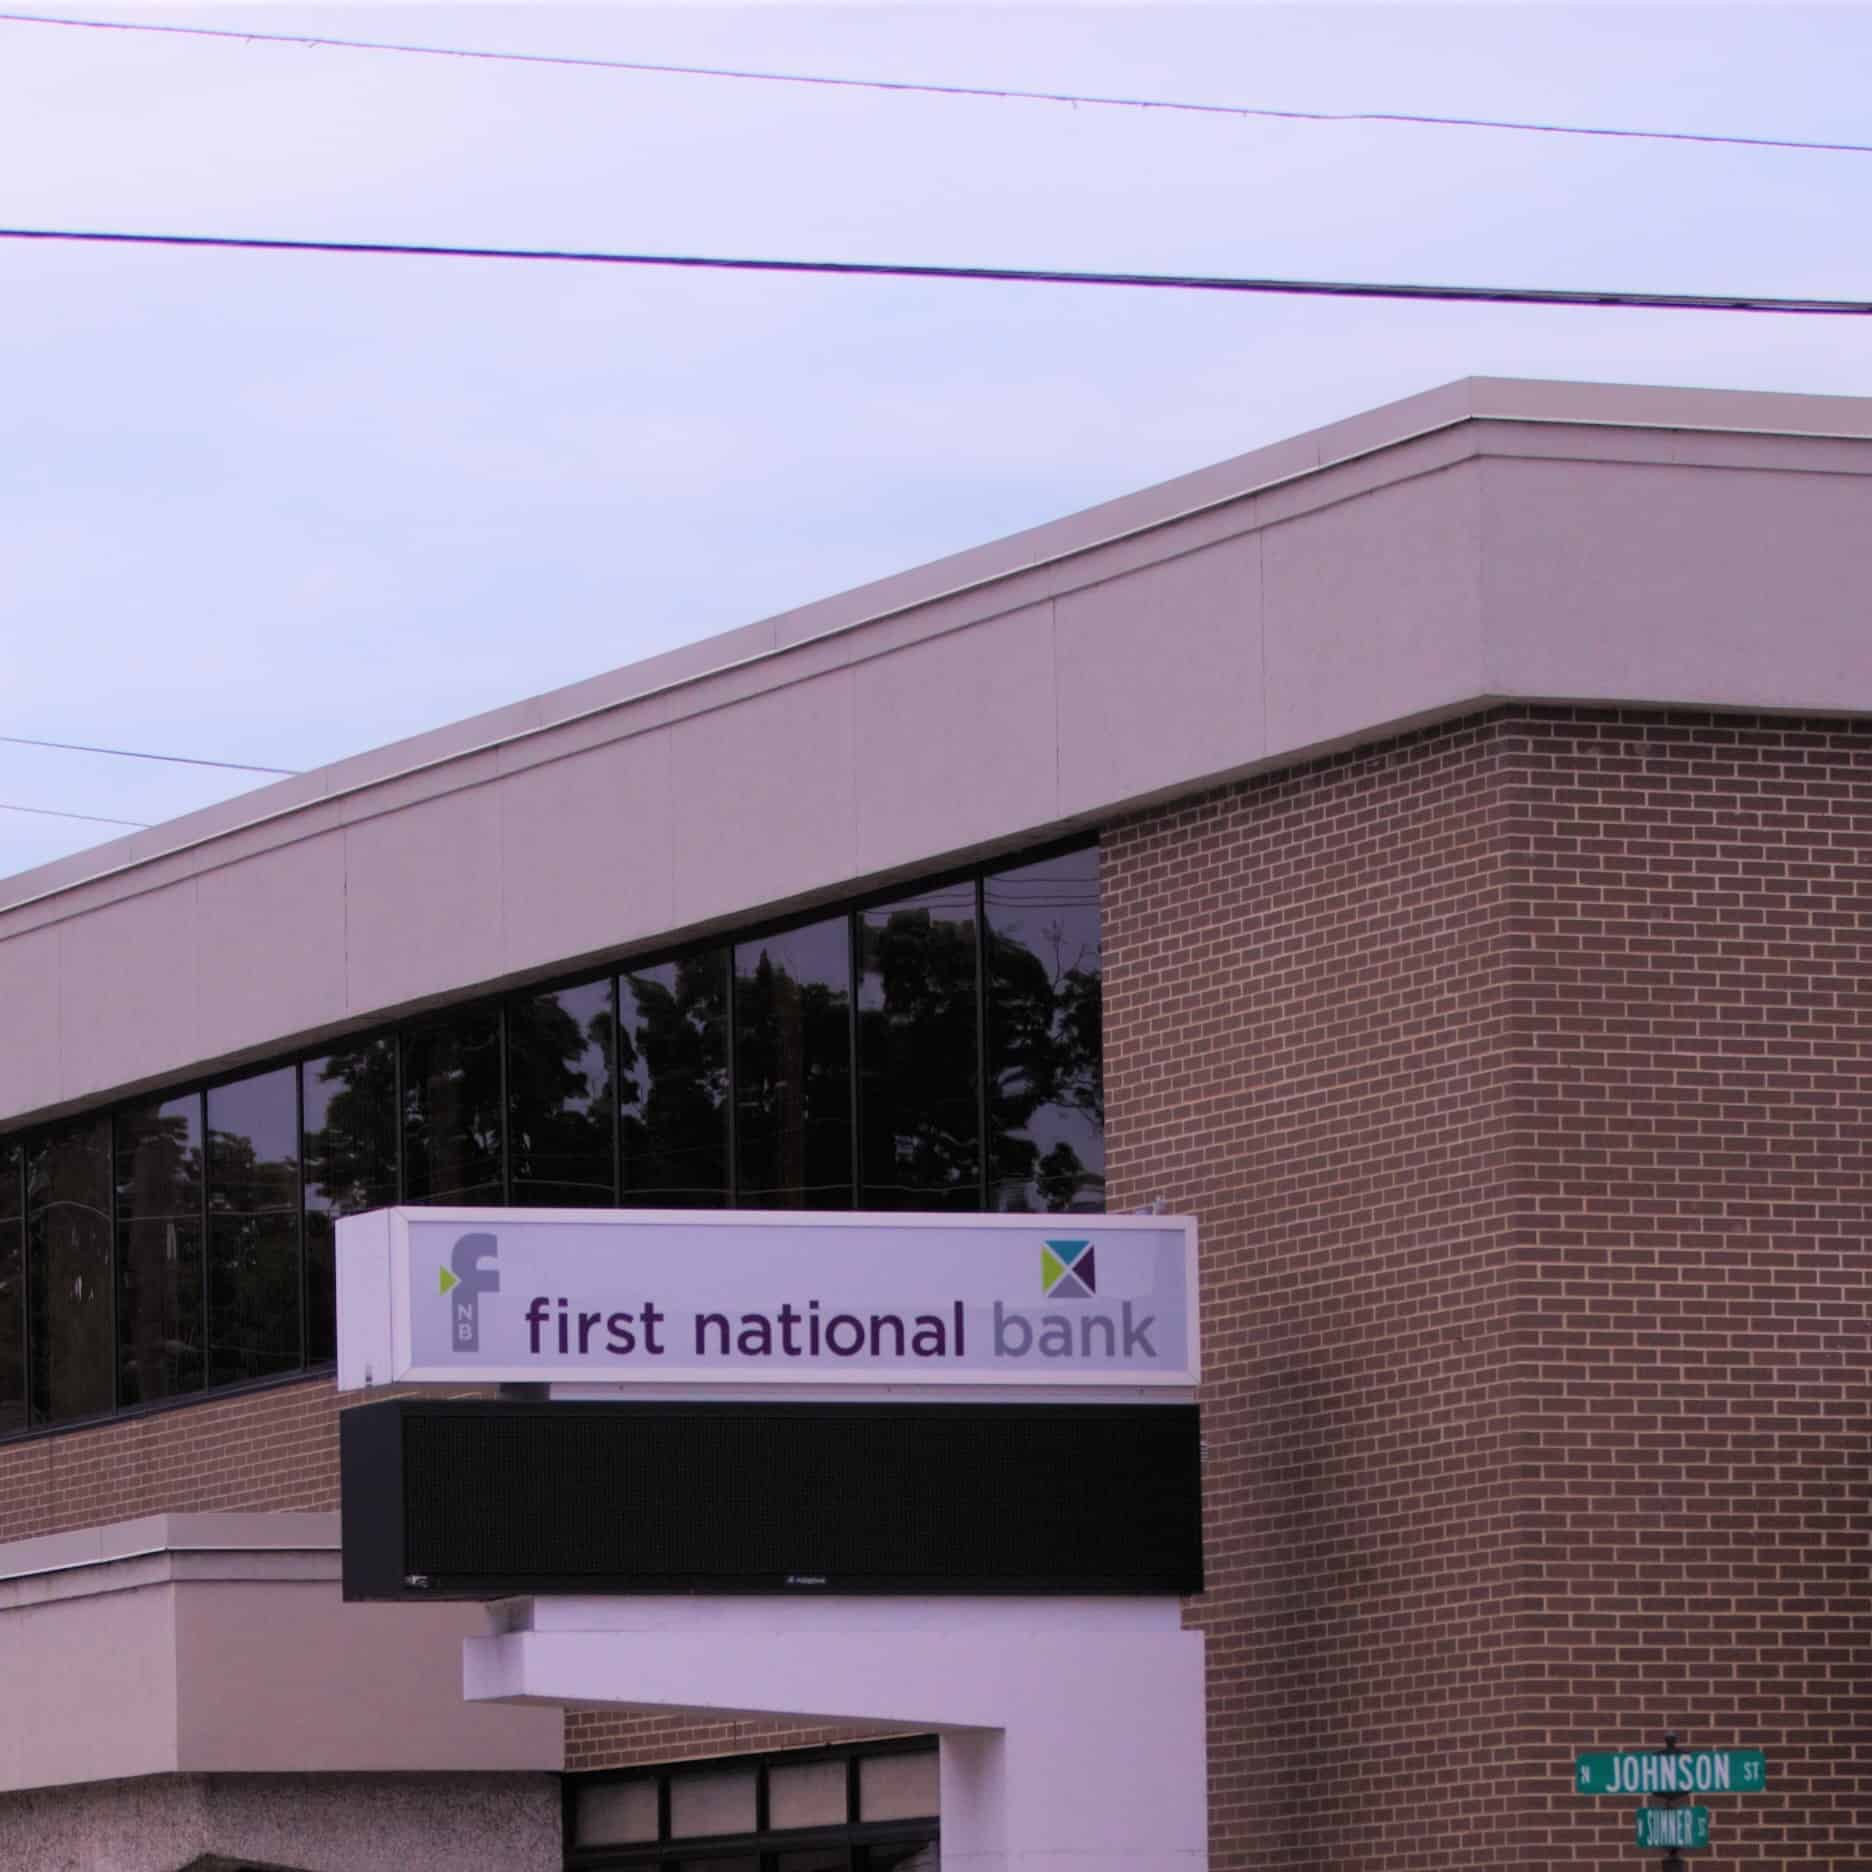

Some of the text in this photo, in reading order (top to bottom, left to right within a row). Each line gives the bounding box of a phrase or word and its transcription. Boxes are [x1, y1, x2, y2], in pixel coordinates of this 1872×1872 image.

[525, 1297, 1159, 1358] first national bank
[1580, 1753, 1760, 1793] N JOHNSON ST
